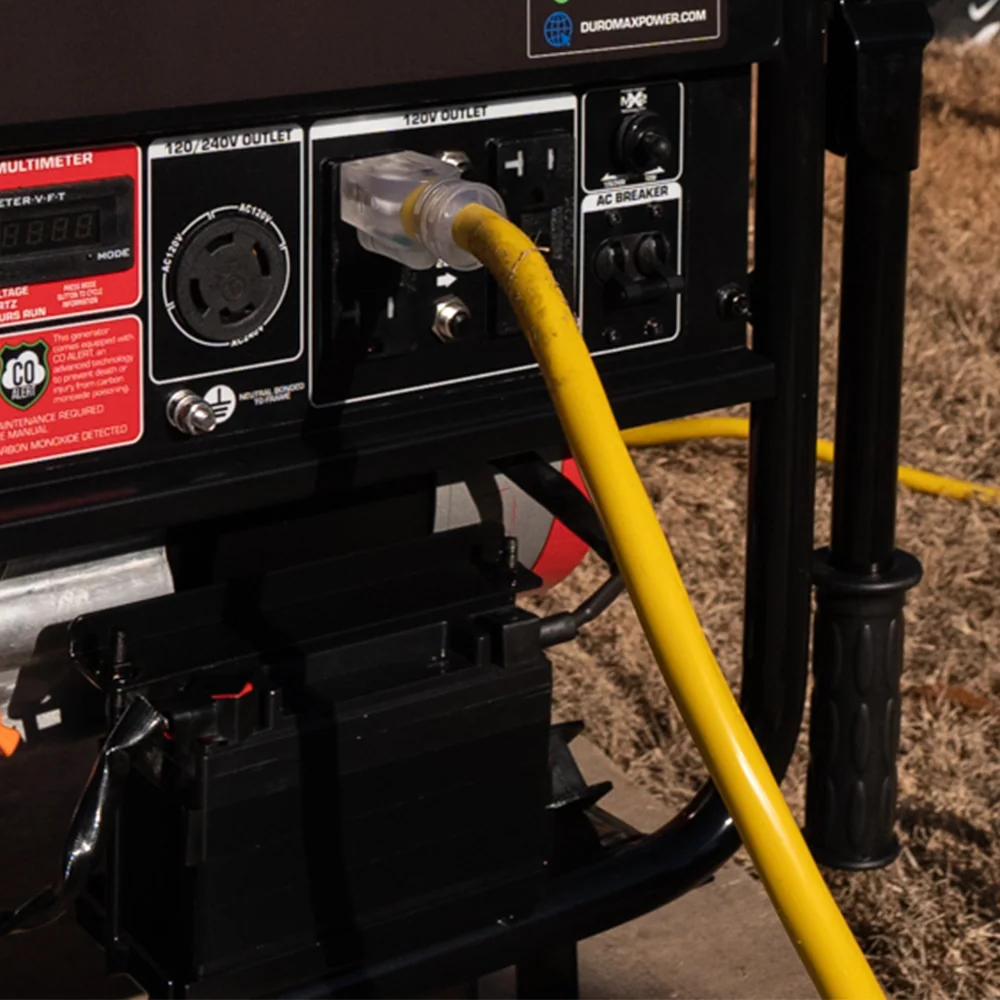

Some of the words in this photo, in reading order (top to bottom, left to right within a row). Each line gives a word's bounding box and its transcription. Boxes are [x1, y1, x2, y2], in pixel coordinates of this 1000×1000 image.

[580, 10, 706, 33] DUROMAXPOWER.COM
[404, 111, 437, 126] 120V
[440, 105, 488, 122] OUTLET
[165, 136, 238, 155] 120/240V
[242, 129, 293, 146] OUTLET
[596, 193, 613, 207] AC
[615, 185, 669, 203] BREAKER
[238, 203, 273, 224] AC120V
[97, 248, 130, 261] MODE
[161, 232, 184, 273] AC120V
[22, 306, 47, 319] RUN
[53, 333, 69, 342] This
[71, 328, 110, 342] generator
[52, 343, 79, 353] comes
[81, 336, 116, 349] equipped
[52, 353, 66, 364] CO
[52, 360, 91, 373] advanced
[91, 355, 134, 368] technology
[13, 360, 34, 386] CO
[52, 376, 62, 384] to
[63, 371, 93, 384] prevent
[95, 366, 117, 376] death
[11, 384, 36, 400] ALERT
[53, 384, 74, 395] injury
[76, 380, 95, 390] from
[96, 375, 125, 387] carbon
[52, 391, 90, 403] monoxide
[58, 404, 105, 420] REQUIRED
[7, 425, 49, 440] MANUAL
[30, 433, 79, 450] MONOXIDE
[81, 424, 129, 441] DETECTED
